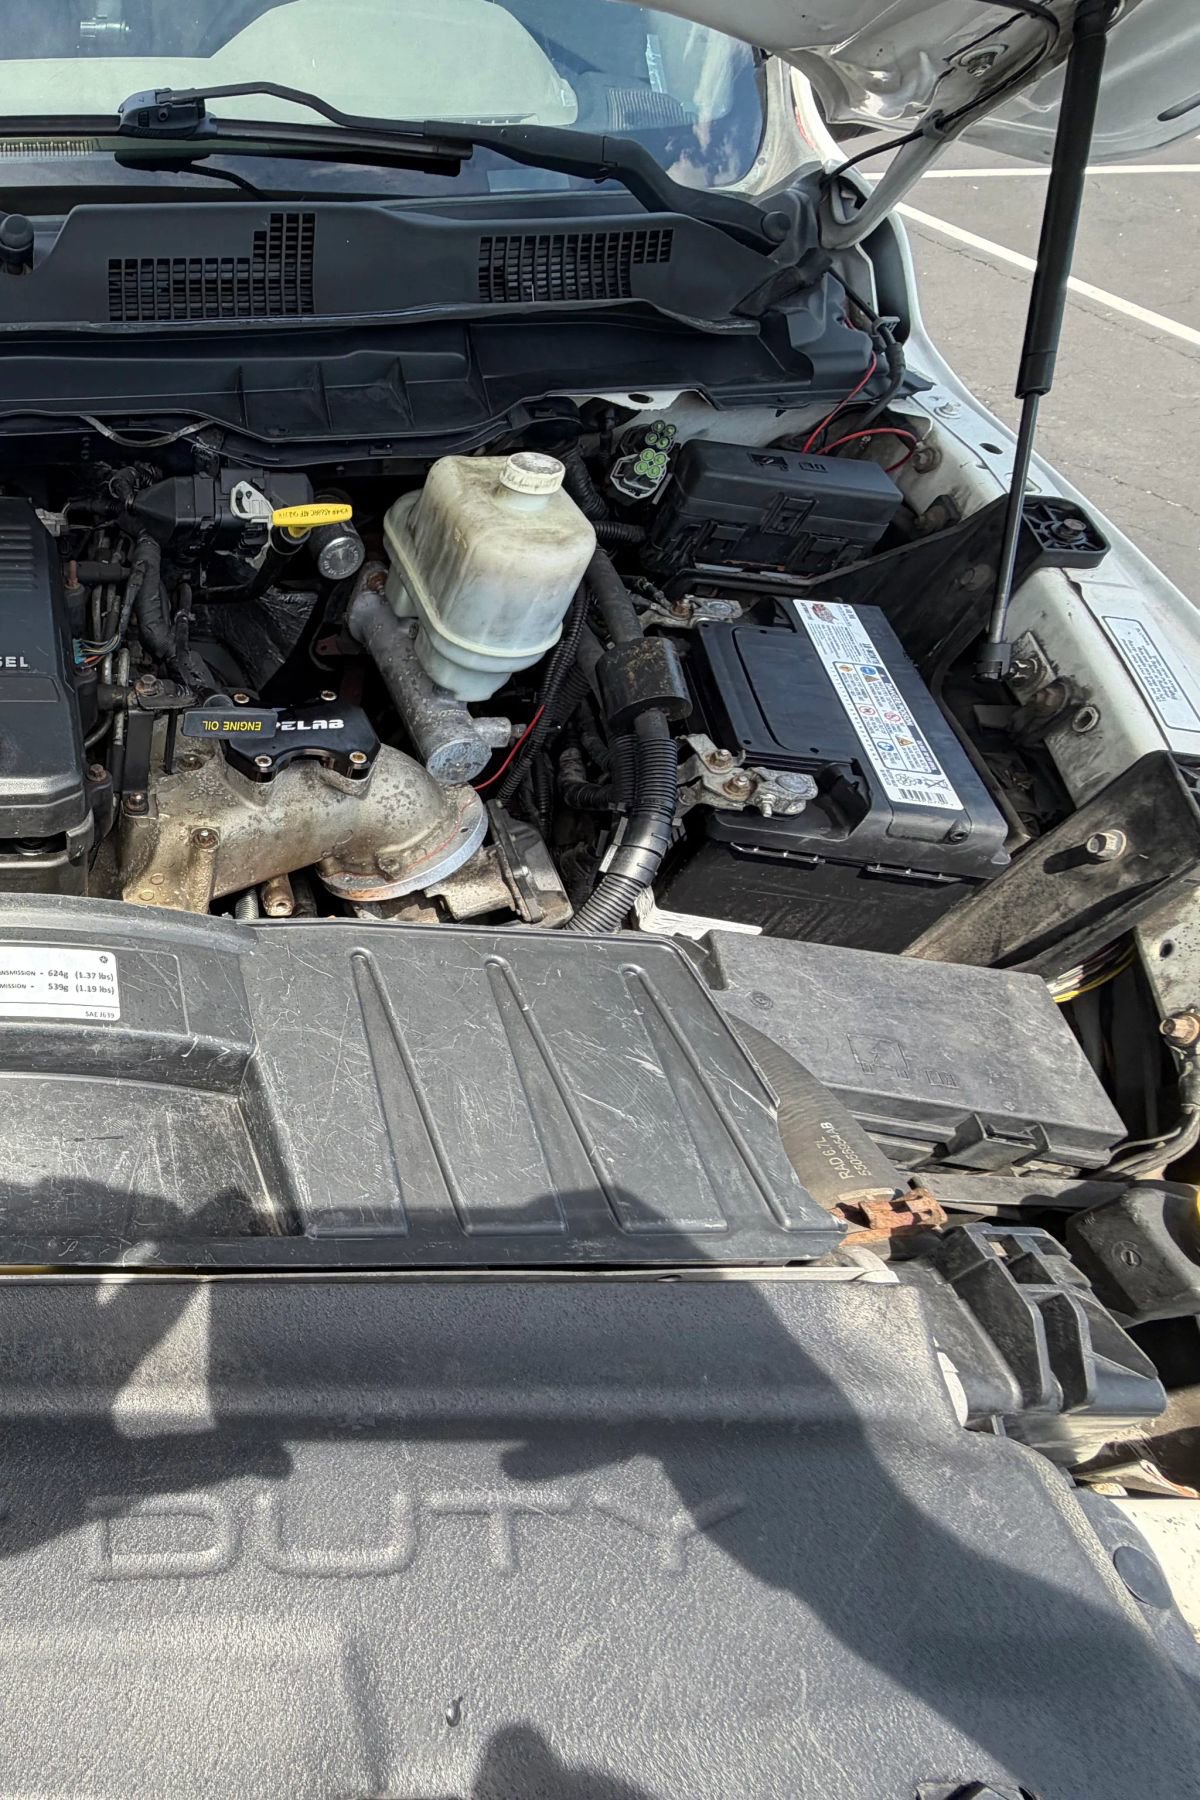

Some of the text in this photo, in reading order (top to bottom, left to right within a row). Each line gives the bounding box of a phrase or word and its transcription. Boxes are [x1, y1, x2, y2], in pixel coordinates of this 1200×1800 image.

[202, 720, 262, 732] ENGINE OIL
[48, 970, 69, 979] 624g
[75, 971, 96, 980] (1.37
[99, 970, 114, 981] lbs)
[48, 983, 69, 992] 539g
[99, 984, 115, 995] lbs)
[814, 1136, 855, 1179] RAD 6.7L
[87, 1492, 748, 1583] DUTY
